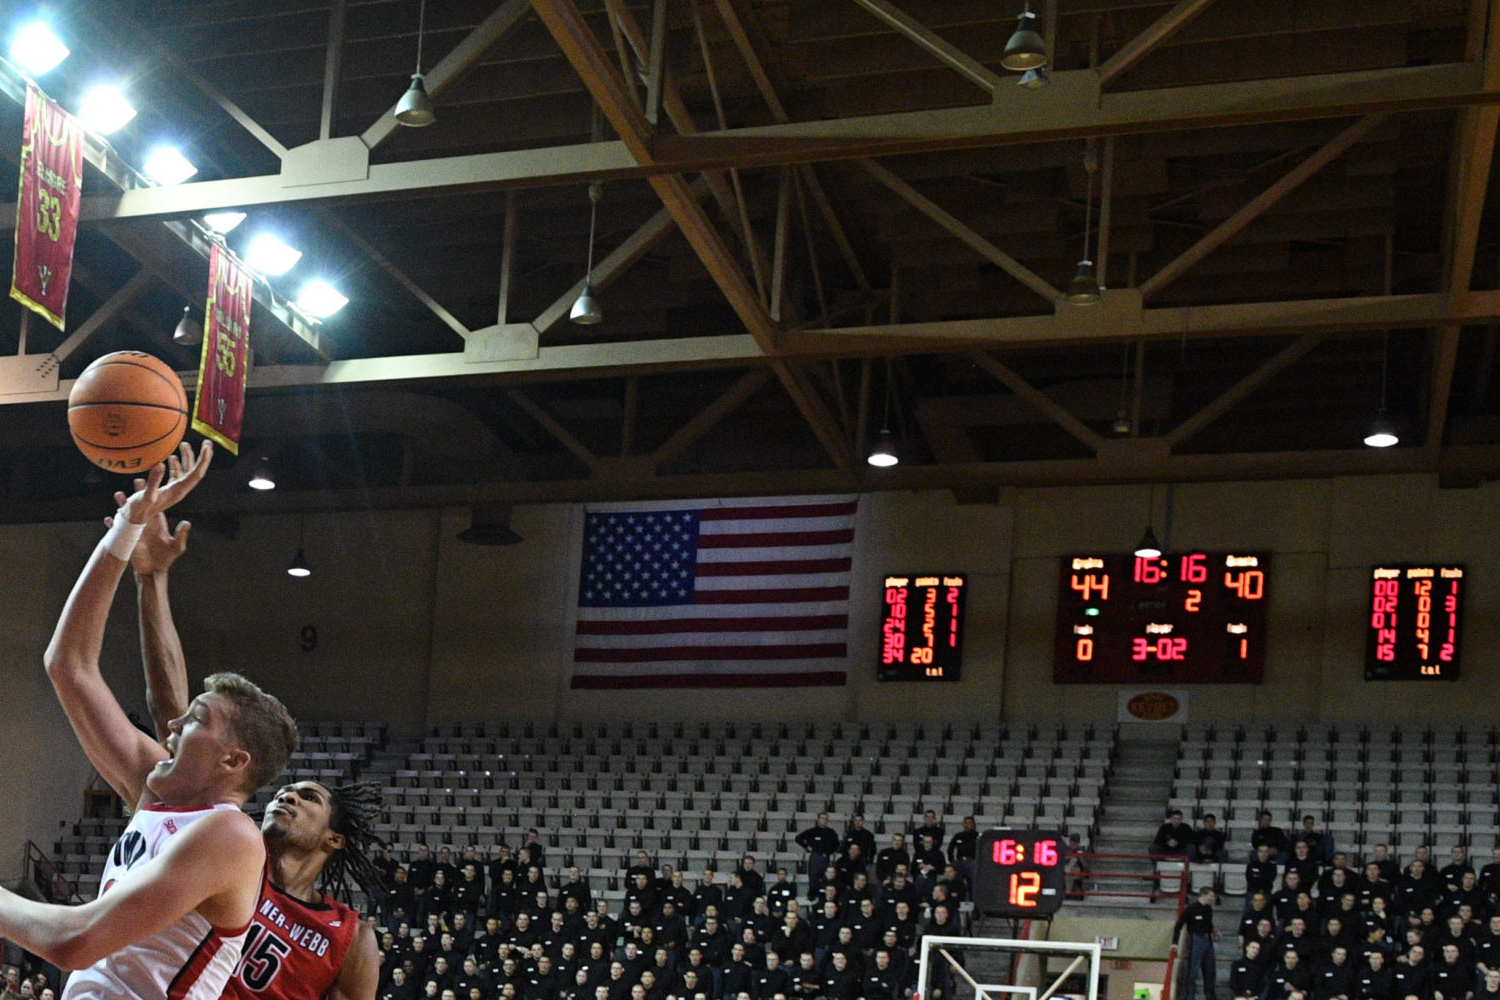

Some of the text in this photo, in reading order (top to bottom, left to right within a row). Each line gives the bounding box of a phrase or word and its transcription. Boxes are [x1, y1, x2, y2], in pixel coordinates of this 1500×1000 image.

[37, 188, 61, 242] 33
[1071, 574, 1109, 600] 44
[1224, 571, 1264, 599] 40
[1374, 580, 1399, 596] 00
[1414, 580, 1432, 596] 12
[886, 587, 959, 604] 02 3 2
[1185, 589, 1201, 612] 2
[1373, 595, 1457, 612] 02 0 3
[891, 603, 907, 618] 10
[1372, 612, 1397, 629] 01
[1417, 612, 1430, 628] 0
[1378, 628, 1396, 644] 14
[1415, 628, 1430, 644] 4
[883, 647, 933, 664] 34 20
[1076, 638, 1093, 661] 0
[1132, 638, 1187, 661] 3-02
[1240, 638, 1248, 659] 1
[1377, 643, 1454, 661] 15 7 2
[1009, 872, 1041, 907] 12
